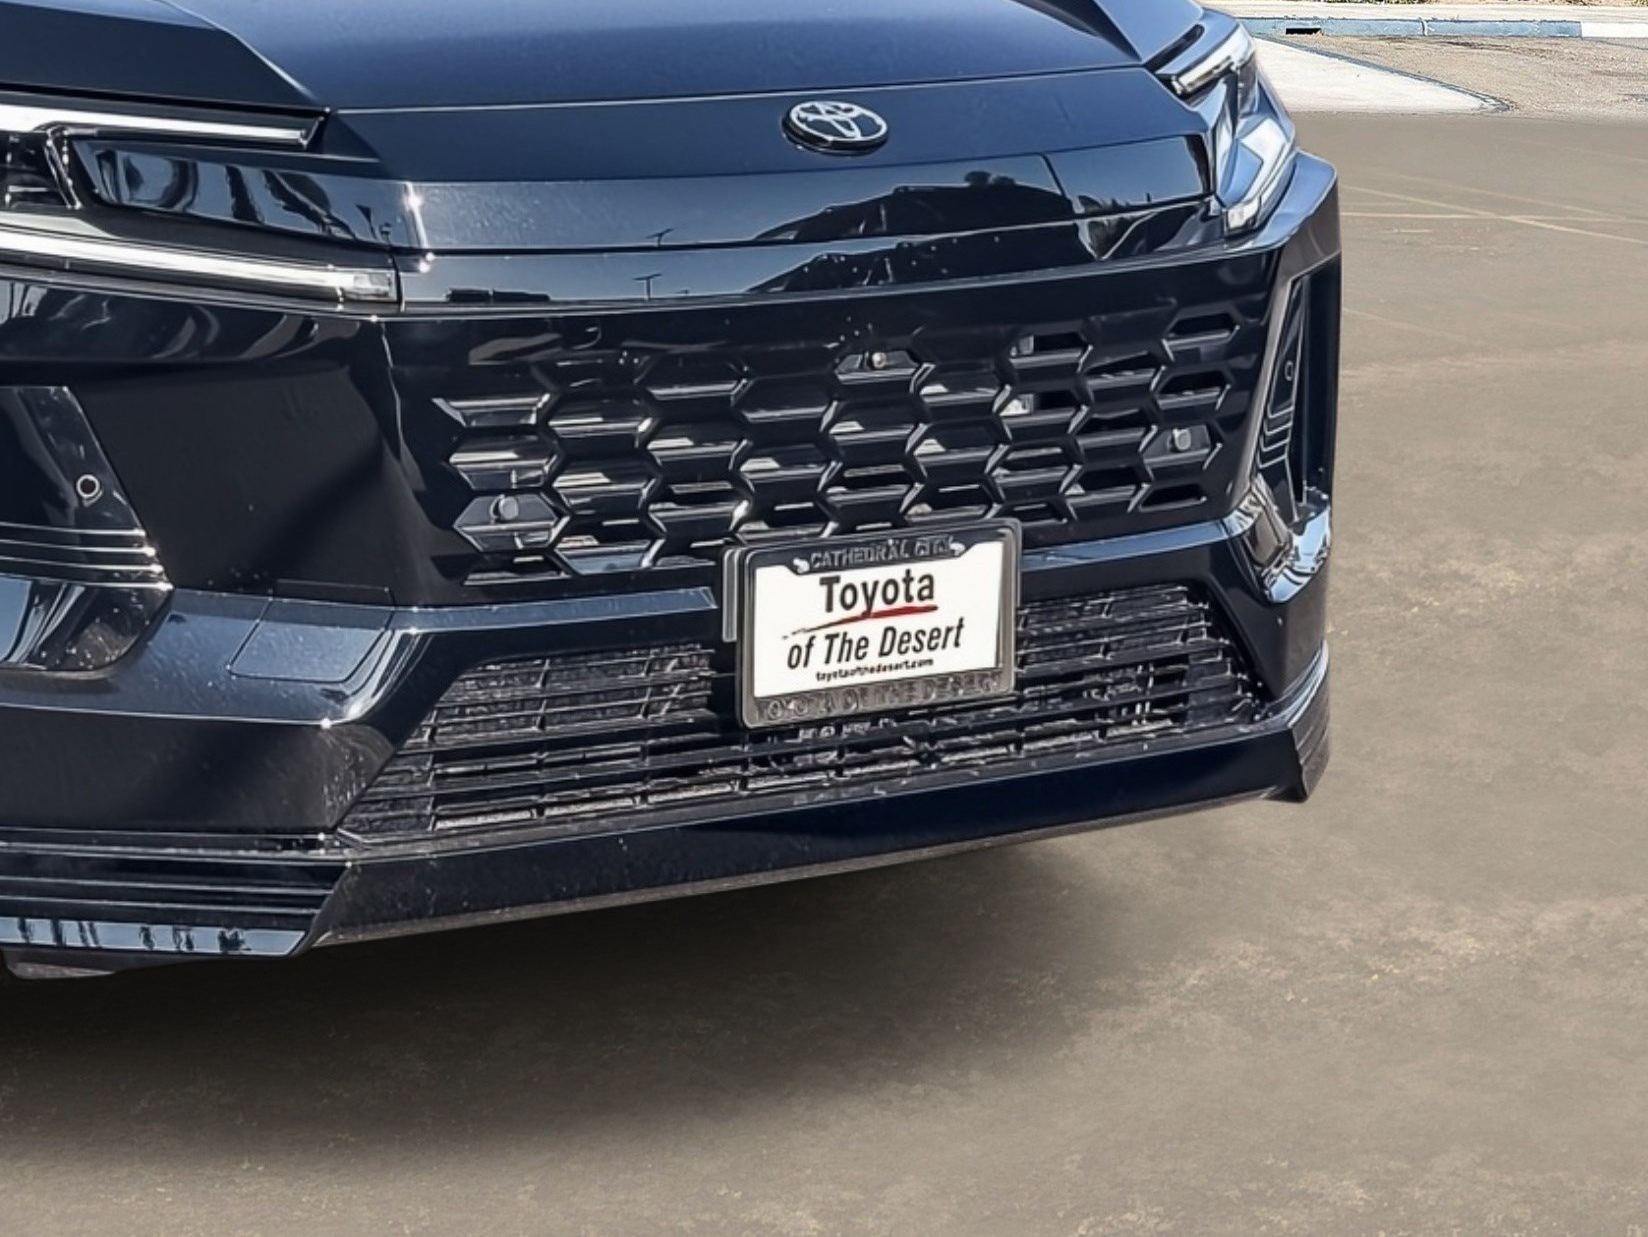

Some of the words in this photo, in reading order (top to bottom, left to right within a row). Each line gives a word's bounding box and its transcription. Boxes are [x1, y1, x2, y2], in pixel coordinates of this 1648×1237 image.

[810, 539, 911, 568] CATHEDRAL
[819, 569, 935, 615] Toyota
[787, 635, 816, 669] of
[823, 629, 870, 664] The
[879, 617, 965, 658] Desert
[815, 658, 934, 683] toyotaofthedesert.com
